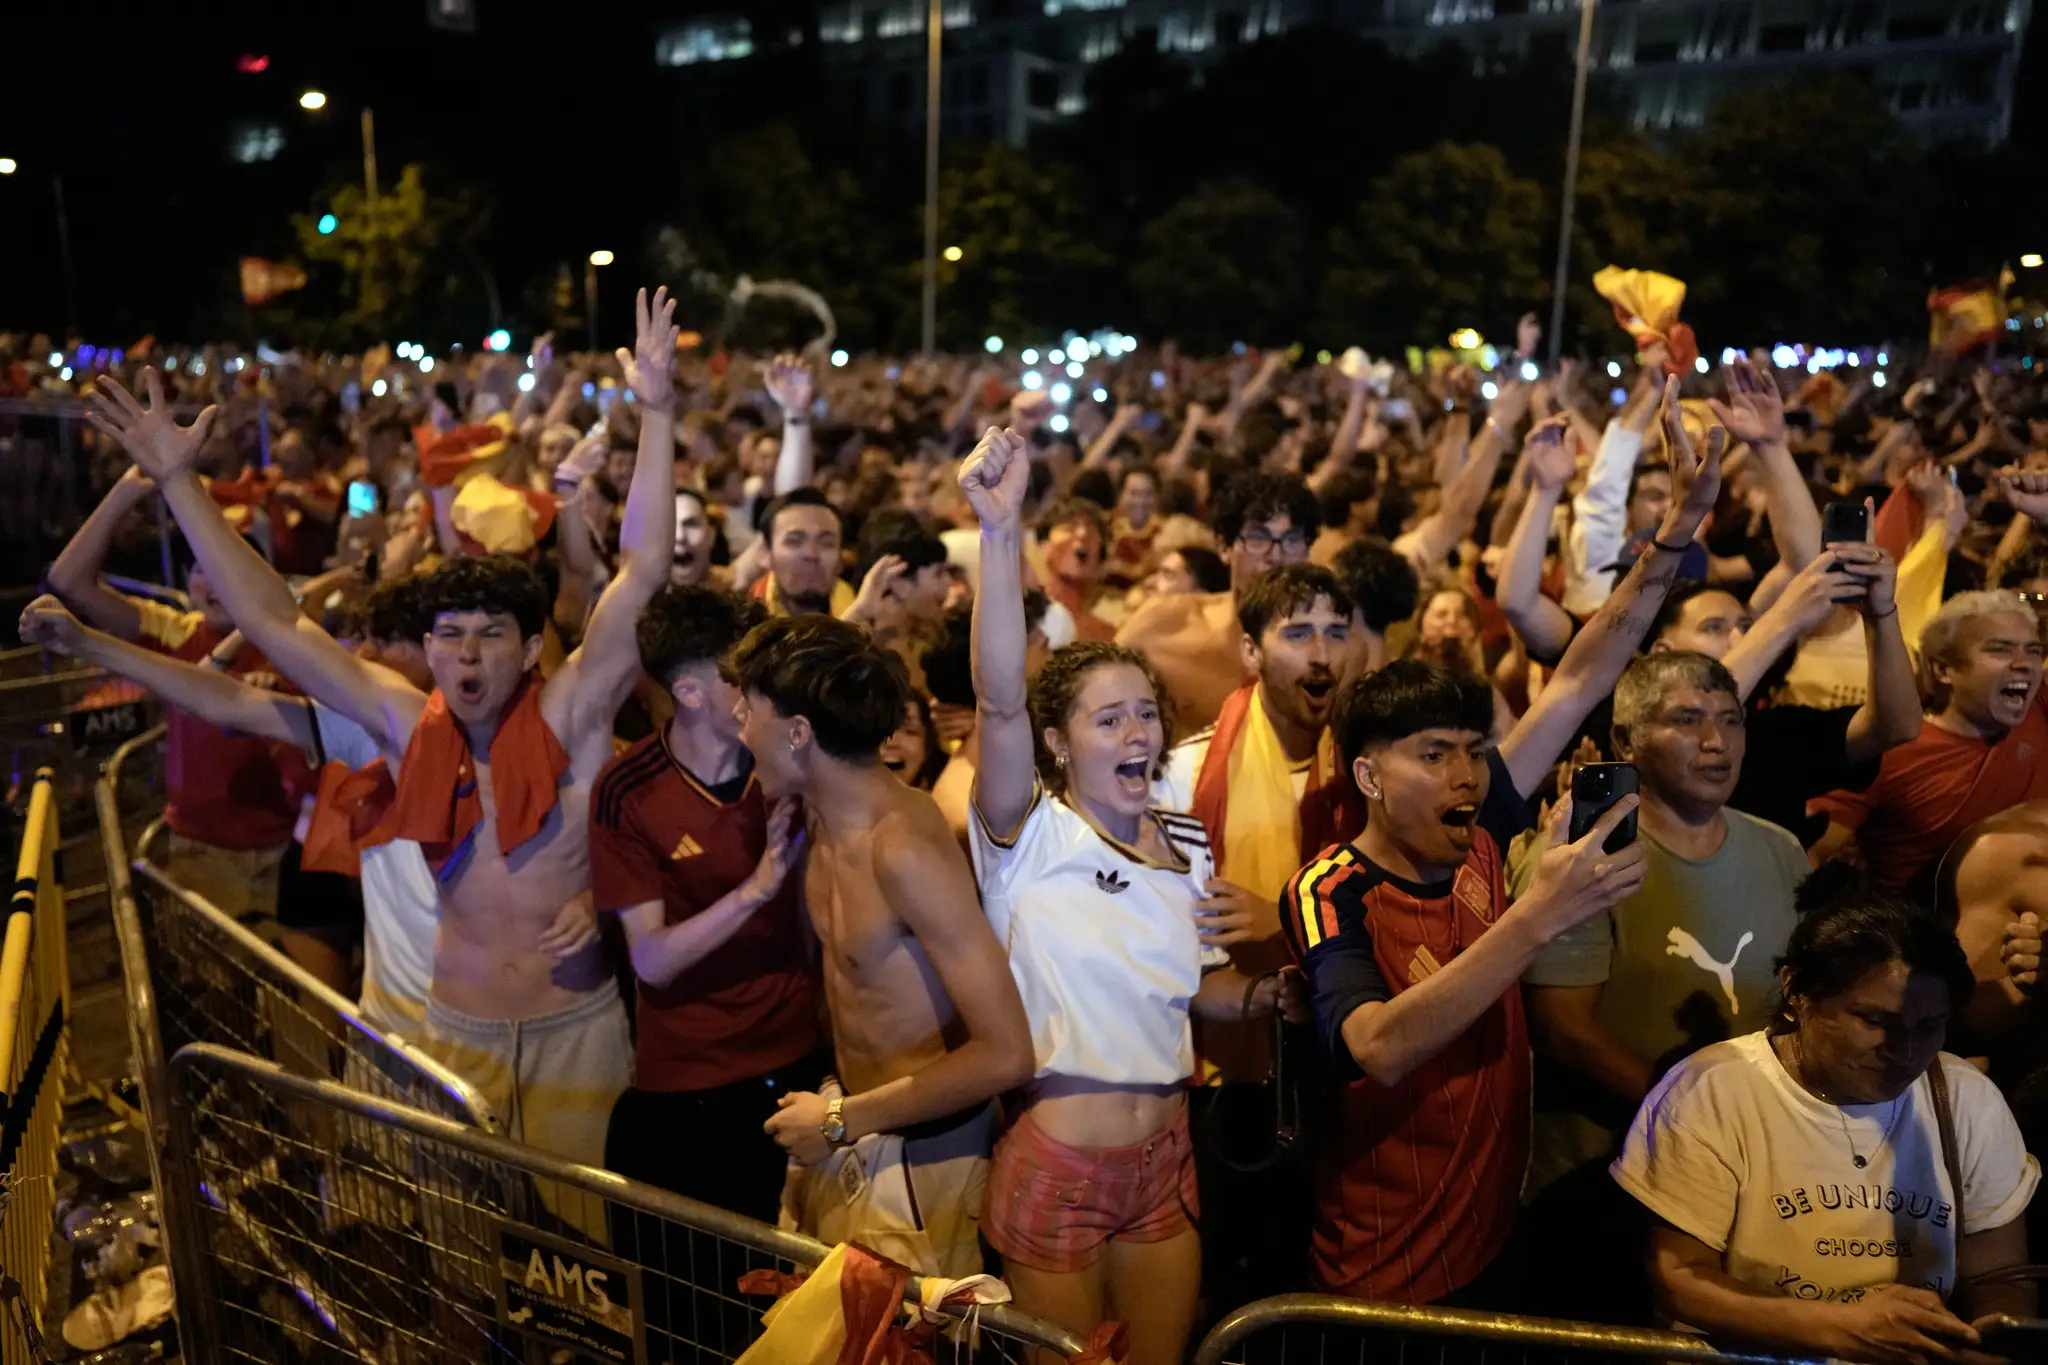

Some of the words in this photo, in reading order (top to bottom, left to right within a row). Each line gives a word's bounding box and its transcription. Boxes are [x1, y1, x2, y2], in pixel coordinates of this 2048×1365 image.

[1770, 1187, 1813, 1220] BE
[1816, 1184, 1952, 1229] UNIQUE
[1815, 1238, 1913, 1258] CHOOSE
[525, 1248, 611, 1314] AMS
